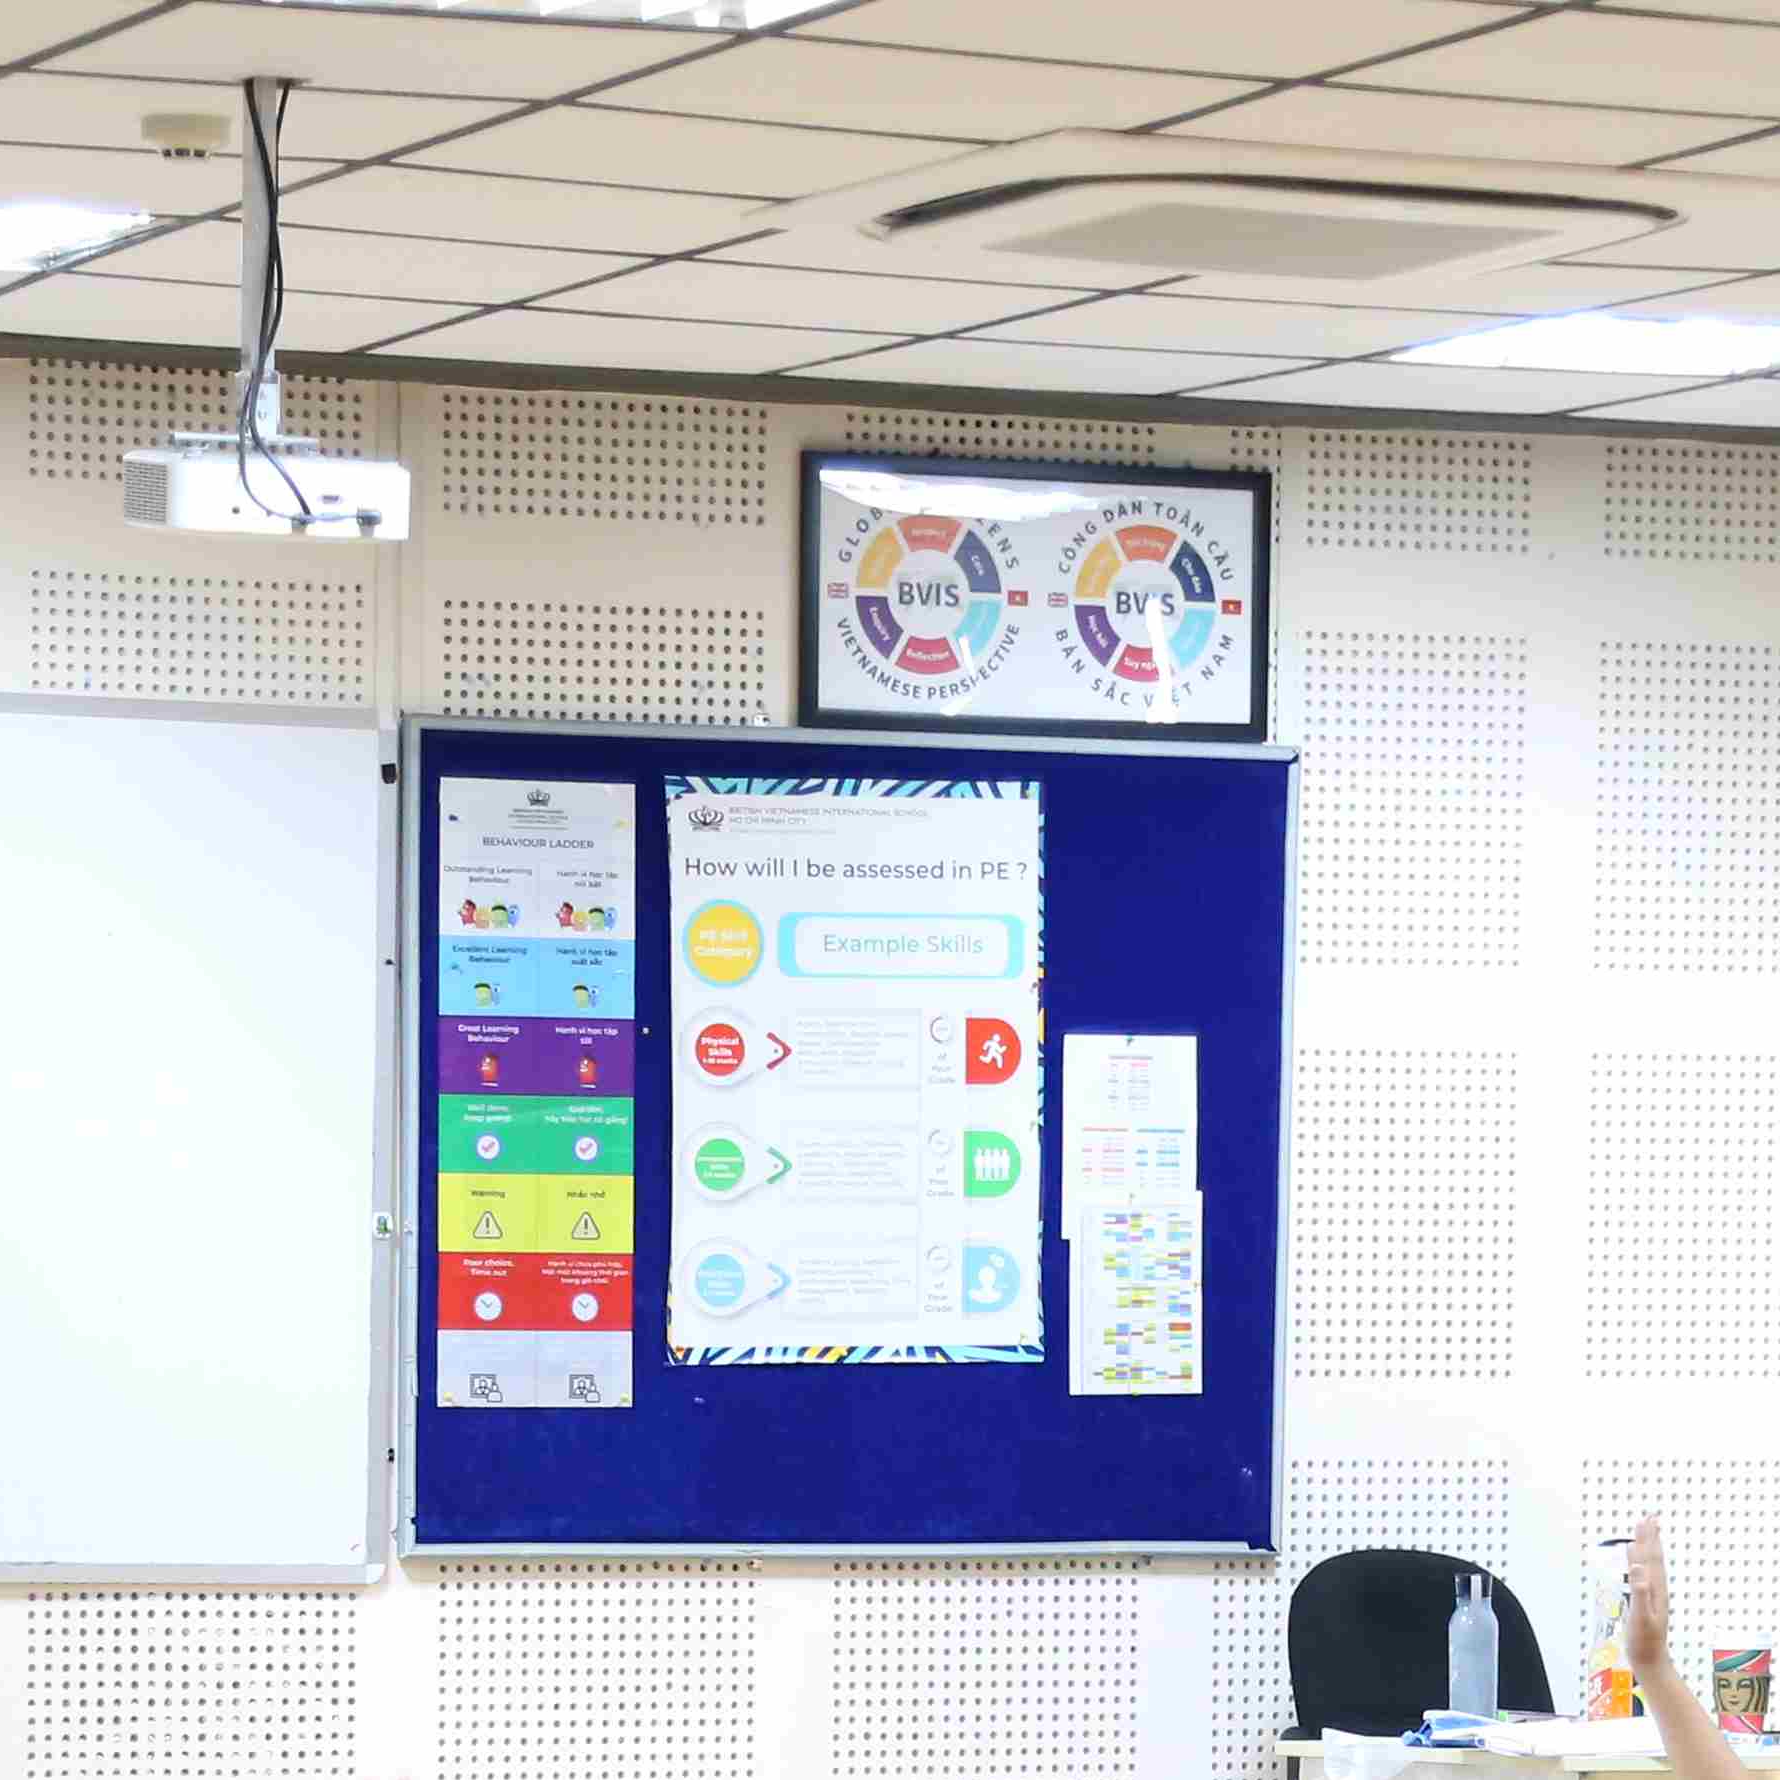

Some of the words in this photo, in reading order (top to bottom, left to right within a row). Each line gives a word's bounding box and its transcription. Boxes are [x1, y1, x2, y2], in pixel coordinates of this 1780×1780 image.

[898, 581, 960, 607] BVIS
[1115, 590, 1176, 616] BVS
[837, 617, 921, 700] VIETNAMESE
[1200, 635, 1235, 681] NAM
[763, 806, 820, 816] VIETNAMESE
[822, 807, 892, 818] INTERNATIONAL
[893, 809, 928, 818] SCHOOL
[482, 836, 547, 848] BEHAVIOUR
[549, 838, 595, 849] LADDER
[685, 857, 738, 878] How
[744, 858, 785, 877] will
[807, 859, 836, 878] be
[842, 859, 945, 879] assessed
[952, 861, 973, 880] in
[981, 861, 1010, 880] PE
[1016, 861, 1028, 881] ?
[823, 934, 919, 957] Example
[927, 934, 984, 955] Skills
[457, 1023, 480, 1033] Great
[482, 1025, 520, 1036] Learning
[467, 1034, 511, 1044] Behaviour
[700, 1036, 740, 1049] Physical
[707, 1047, 733, 1057] Skills
